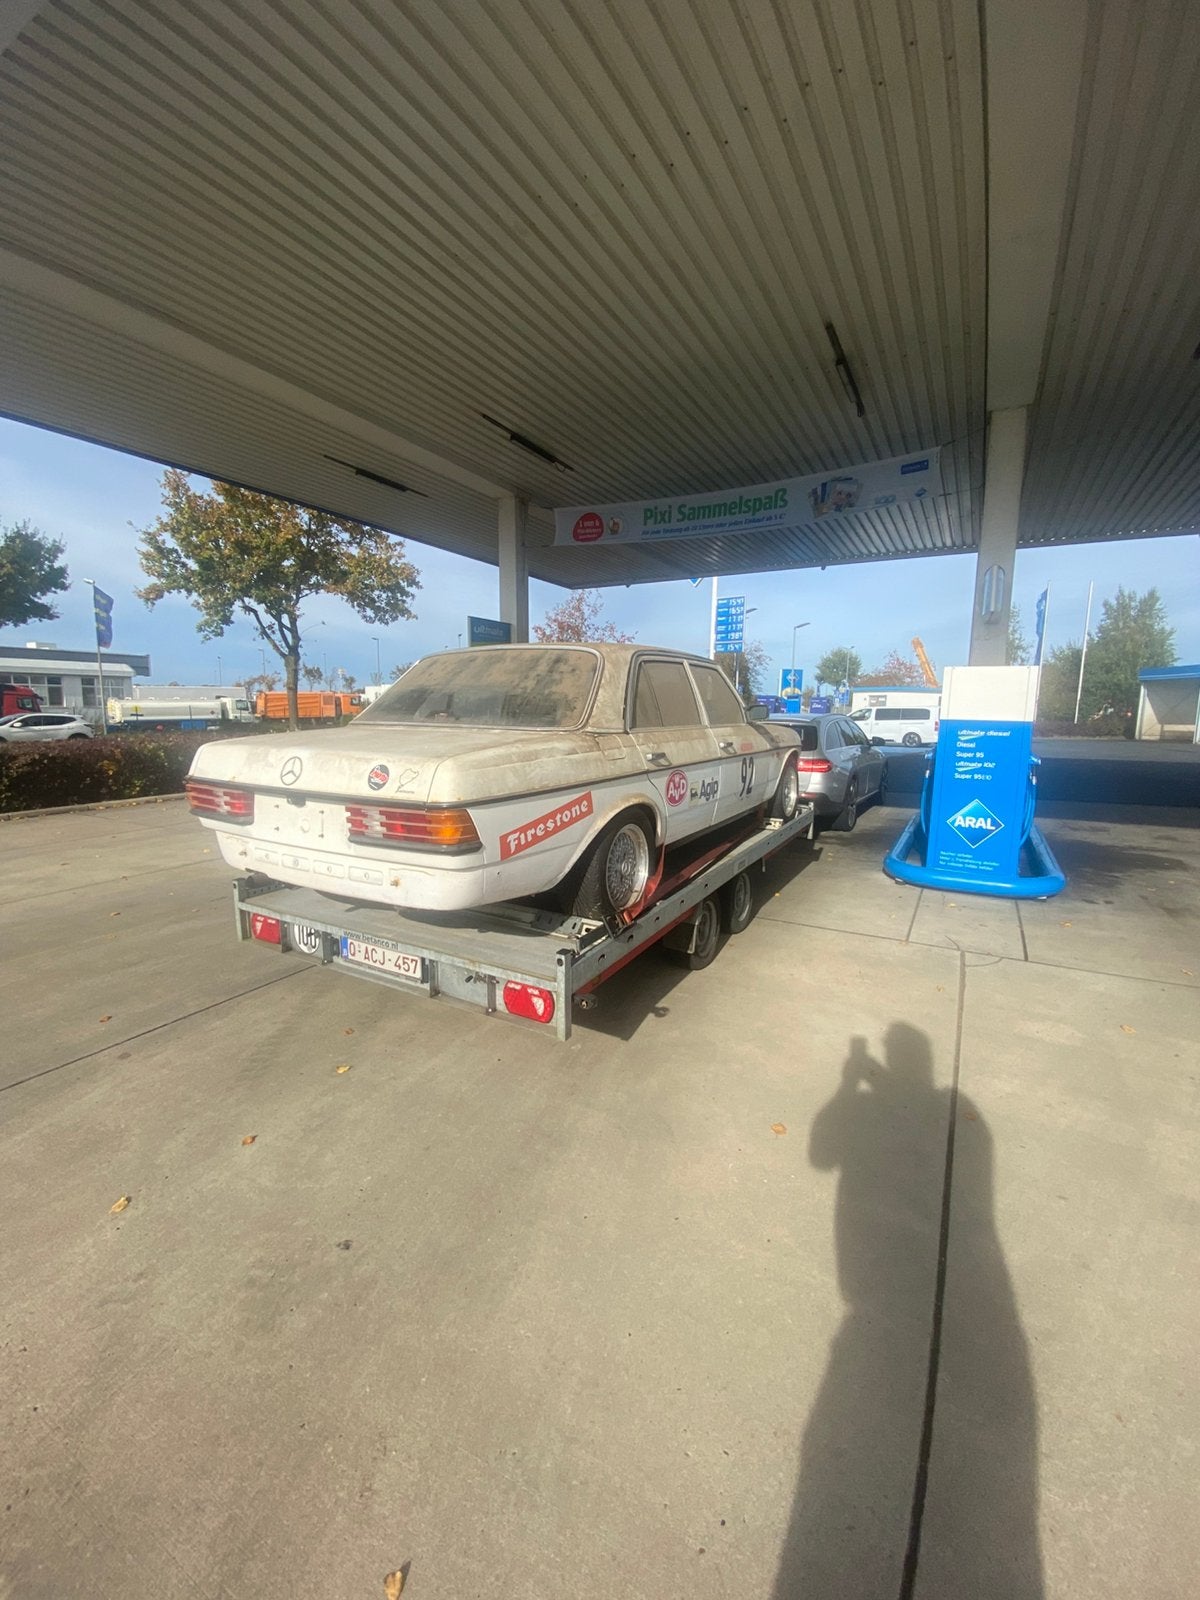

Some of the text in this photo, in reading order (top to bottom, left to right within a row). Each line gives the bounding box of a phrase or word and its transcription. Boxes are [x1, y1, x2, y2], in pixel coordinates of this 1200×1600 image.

[643, 487, 789, 525] Pixi Sammelspaß
[699, 777, 719, 802] Agip
[739, 756, 754, 797] 92
[506, 800, 589, 854] Firestone
[954, 815, 996, 830] ARAL
